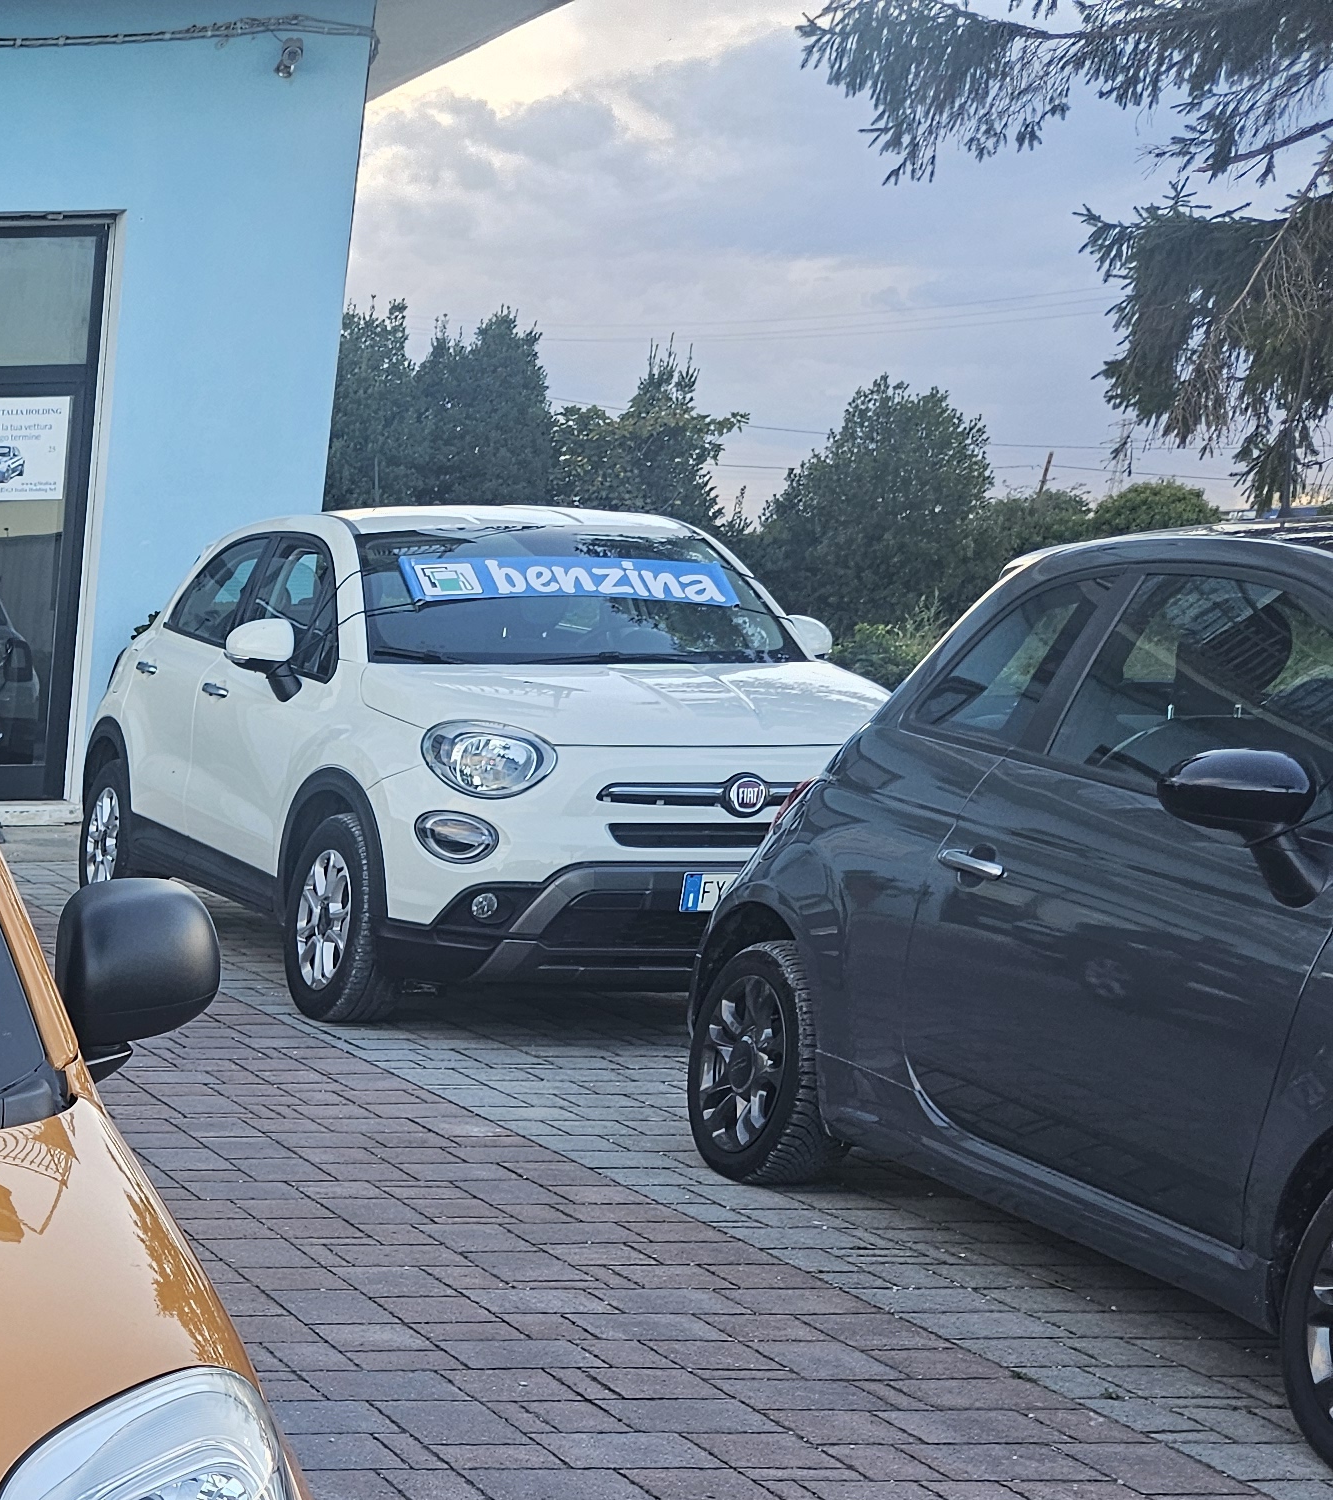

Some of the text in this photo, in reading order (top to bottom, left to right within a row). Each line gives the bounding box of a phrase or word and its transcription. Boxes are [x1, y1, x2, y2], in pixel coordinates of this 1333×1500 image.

[25, 408, 62, 416] HOLDING
[2, 423, 8, 431] la
[24, 423, 53, 431] vettura
[10, 433, 42, 441] termine
[485, 559, 726, 603] benzina
[738, 788, 758, 804] FIAT
